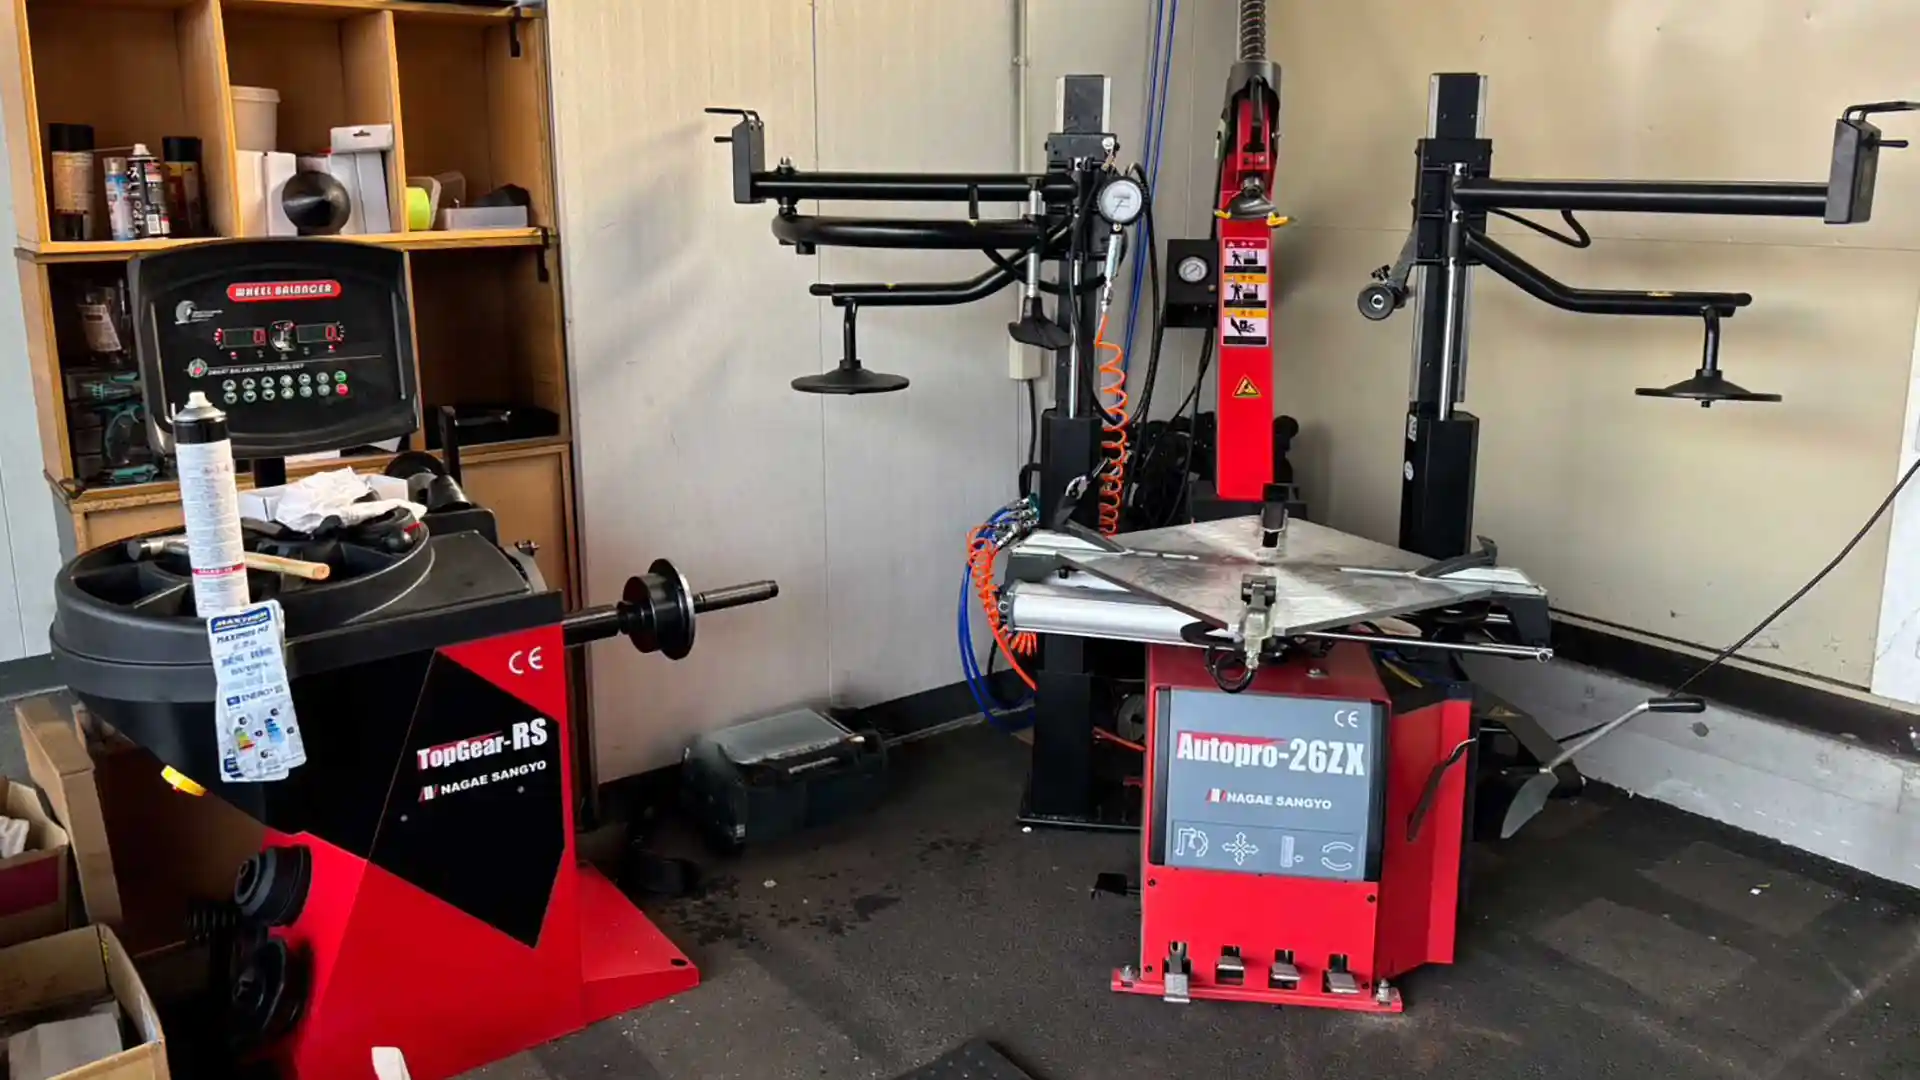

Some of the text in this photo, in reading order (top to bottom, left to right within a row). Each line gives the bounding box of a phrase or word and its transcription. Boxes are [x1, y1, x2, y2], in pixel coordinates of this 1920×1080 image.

[235, 284, 333, 297] WHEEL BALANCER
[416, 717, 548, 770] TopGear-RS
[1177, 732, 1365, 776] Autopro-26ZX
[440, 760, 547, 795] NAGAE SANGYO
[1226, 789, 1332, 810] NAGAE SANGYO
